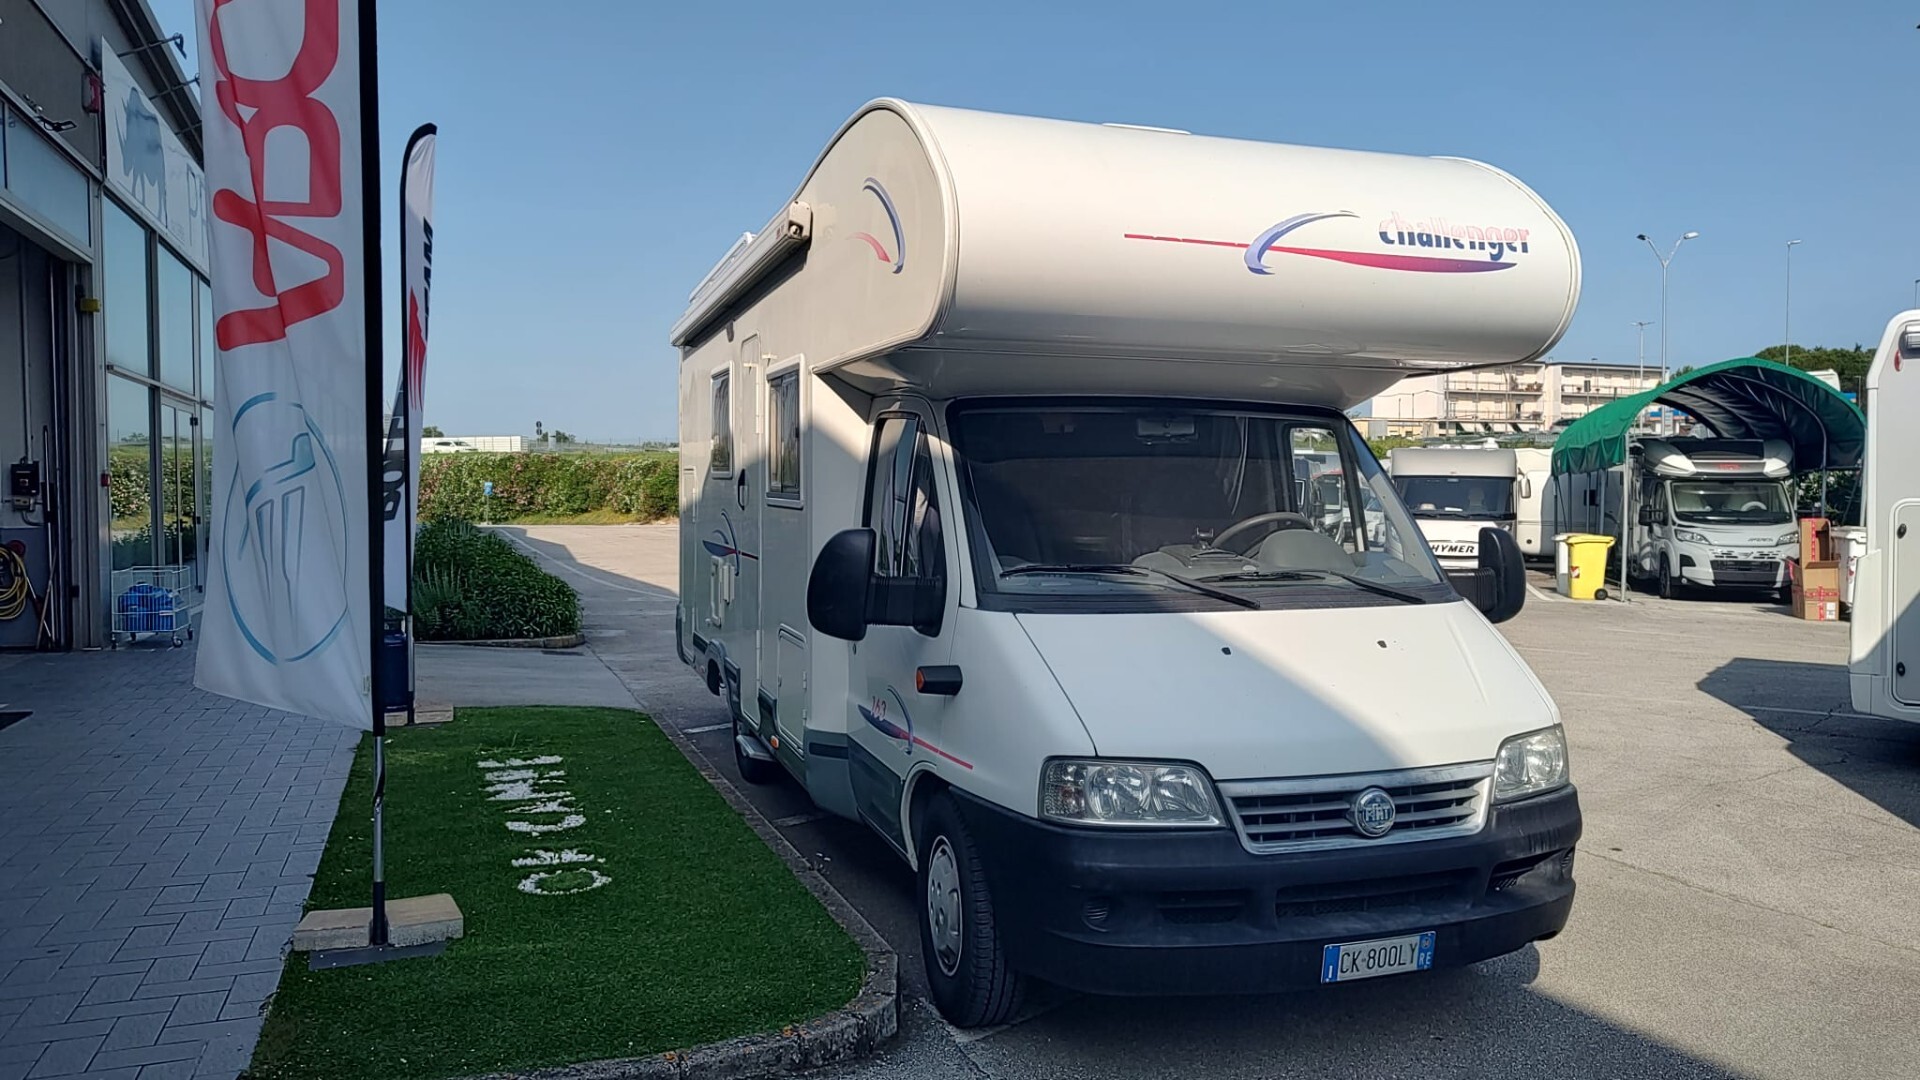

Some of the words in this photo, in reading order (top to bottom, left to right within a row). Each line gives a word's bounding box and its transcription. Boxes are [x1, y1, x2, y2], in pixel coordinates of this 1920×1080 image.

[1379, 210, 1530, 262] challenger
[1431, 544, 1475, 554] HYMER
[872, 696, 887, 722] 163
[1364, 803, 1392, 822] FIAT
[1418, 951, 1433, 966] RE
